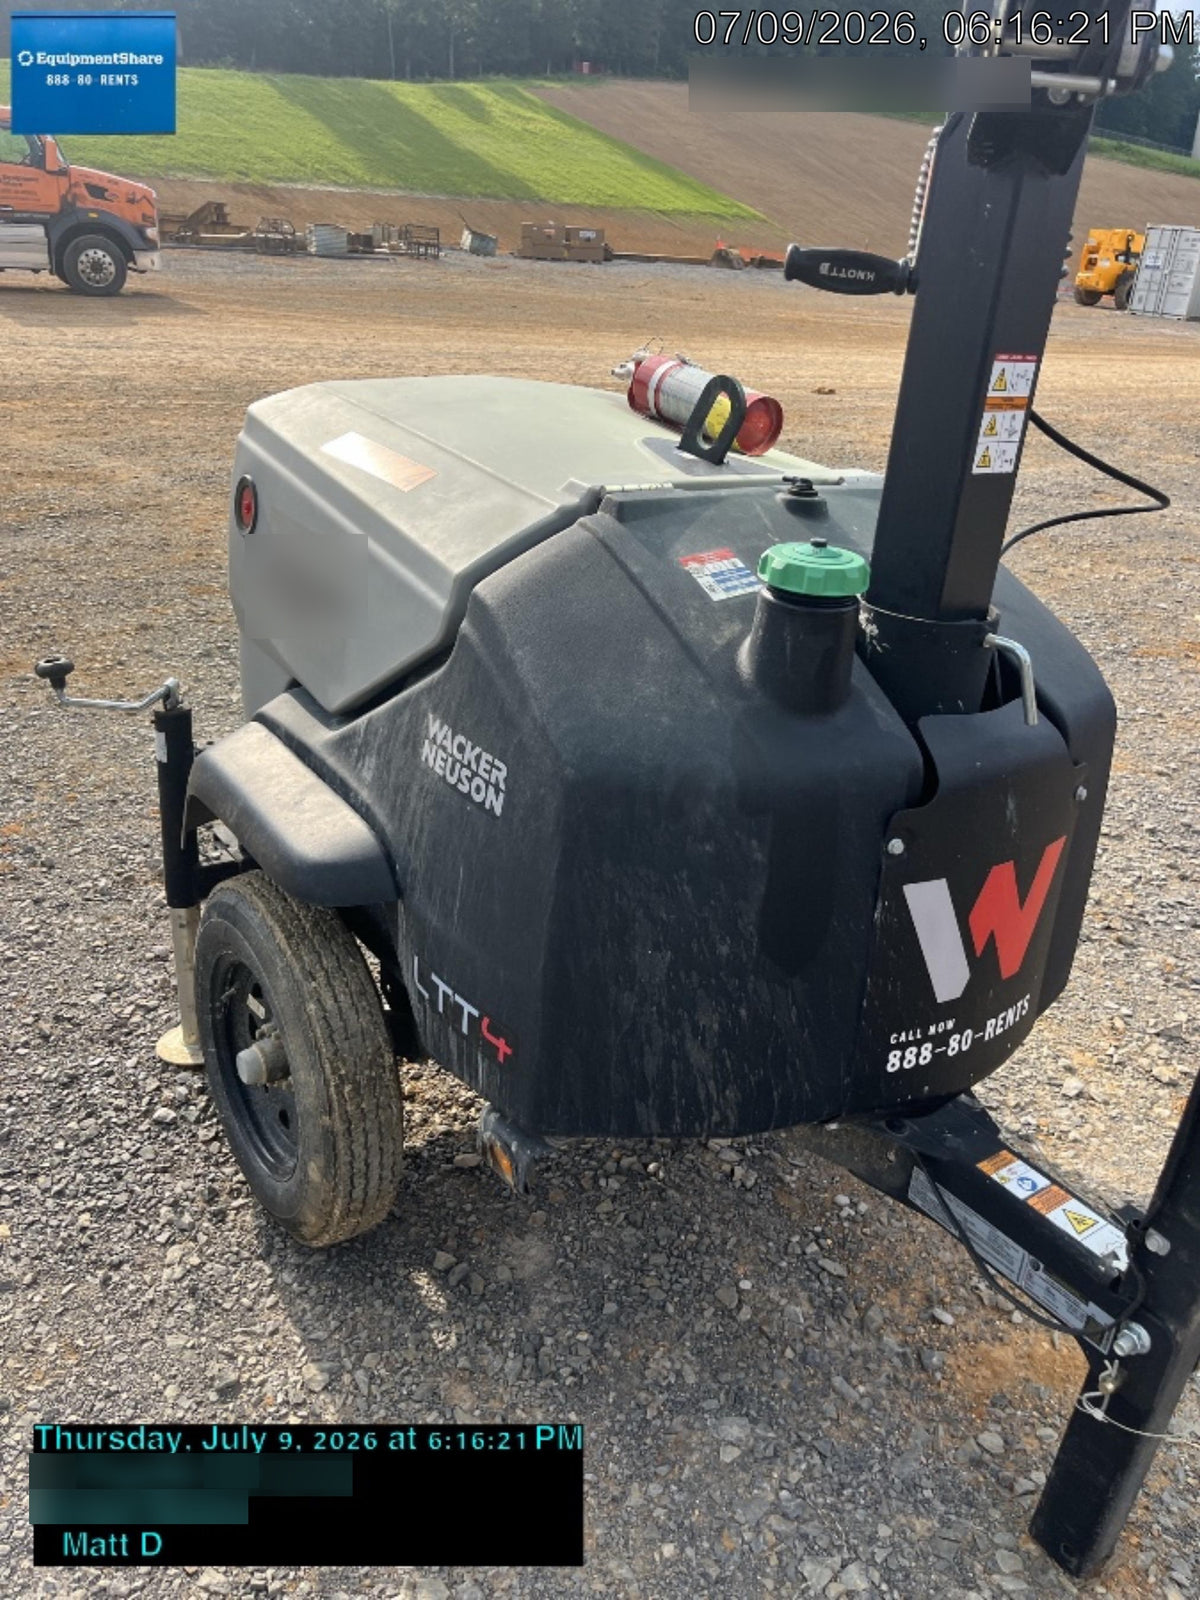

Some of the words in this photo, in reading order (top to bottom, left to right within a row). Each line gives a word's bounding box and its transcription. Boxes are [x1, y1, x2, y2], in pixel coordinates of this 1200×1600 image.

[829, 267, 876, 281] KNOTT
[421, 739, 504, 816] NEUSON
[427, 712, 507, 791] WACKER
[886, 993, 1031, 1073] 888-80-RENTS
[889, 1028, 921, 1044] CALL
[927, 1018, 955, 1035] NOW
